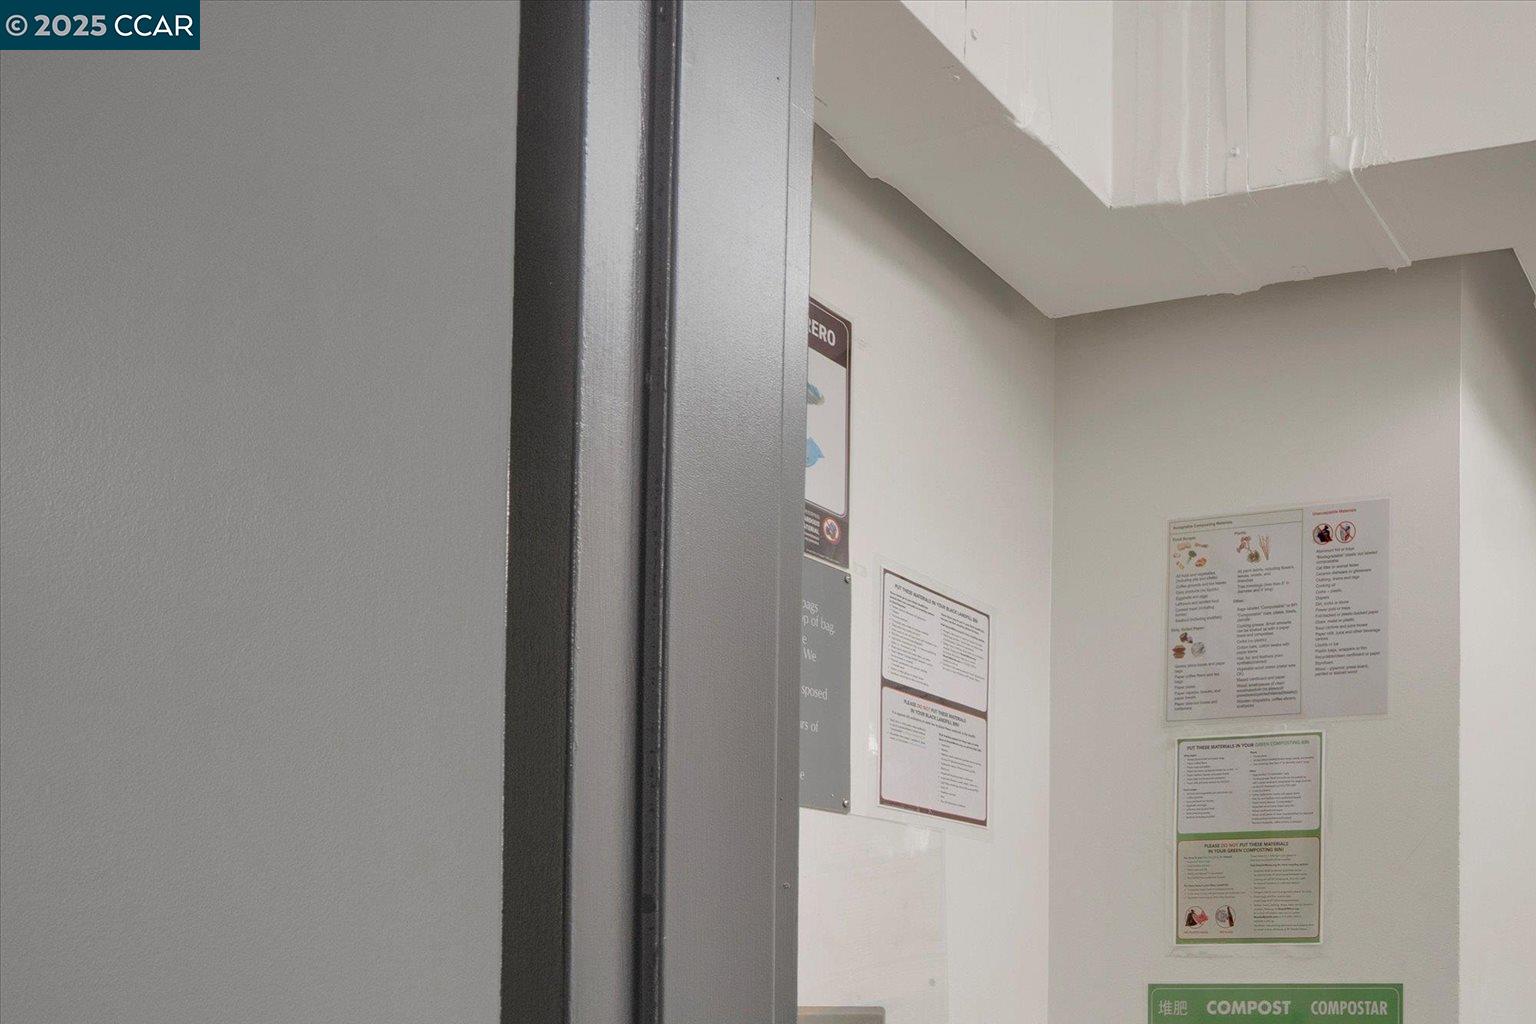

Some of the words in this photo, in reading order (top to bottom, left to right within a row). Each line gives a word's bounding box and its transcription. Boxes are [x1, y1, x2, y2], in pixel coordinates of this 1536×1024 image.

[1158, 1000, 1188, 1016] 堆肥
[1206, 1000, 1291, 1016] COMPOST
[1311, 1000, 1388, 1016] COMPOSTAR
